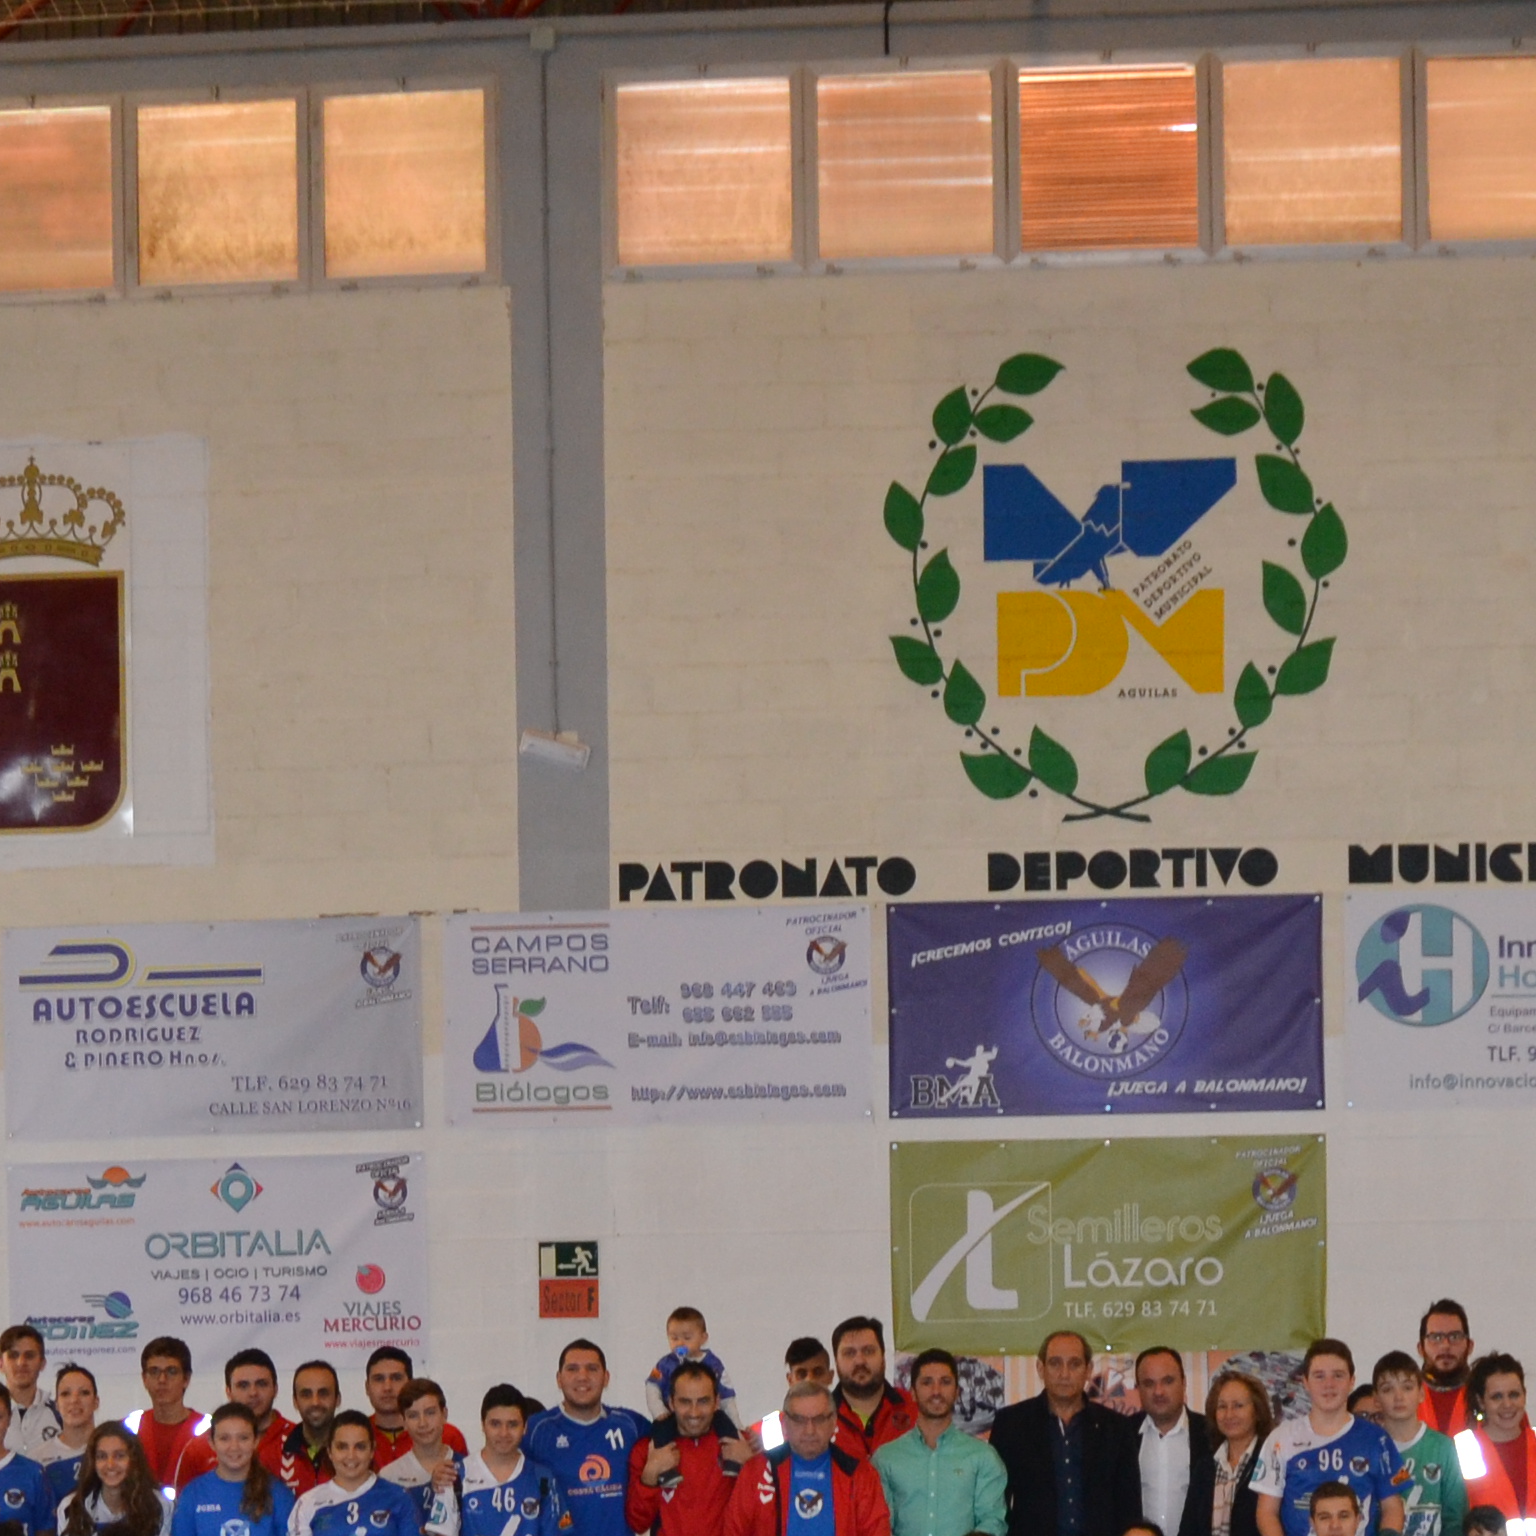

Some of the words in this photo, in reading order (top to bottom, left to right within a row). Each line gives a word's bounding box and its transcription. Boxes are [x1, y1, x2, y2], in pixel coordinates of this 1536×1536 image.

[1132, 539, 1192, 598] PATRONATO
[1144, 552, 1202, 609] DEPORTIVO
[1154, 564, 1212, 620] MUNICIPAL
[1118, 688, 1178, 699] AGUILAS
[618, 856, 916, 902] PATRONATO
[987, 847, 1279, 891] DEPORTIVO
[471, 933, 609, 954] CAMPOS
[998, 921, 1072, 947] CONTIGO!
[471, 955, 609, 975] SERRANO
[32, 992, 257, 1023] AUTOESCUELA
[75, 1026, 202, 1045] RODRIGUEZ
[1048, 1028, 1170, 1073] BALONMANO
[1488, 1045, 1521, 1063] TLF.
[231, 1075, 271, 1093] TLF.
[278, 1075, 310, 1094] 629
[316, 1075, 338, 1094] 83
[343, 1076, 364, 1094] 74
[369, 1076, 387, 1092] 71
[476, 1080, 609, 1104] Biólogos
[1176, 1081, 1187, 1093] A
[1194, 1078, 1307, 1095] BALONMANO!
[209, 1102, 258, 1117] CALLE
[262, 1101, 292, 1116] SAN
[298, 1100, 371, 1114] LORENZO
[1027, 1203, 1223, 1244] Semilleros
[145, 1228, 332, 1260] ORBITALIA
[151, 1268, 200, 1281] VIAJES
[213, 1267, 249, 1280] OCIO
[263, 1265, 328, 1279] TURISMO
[1064, 1244, 1223, 1289] Lázaro
[178, 1286, 212, 1304] 968
[220, 1286, 242, 1303] 46
[248, 1285, 270, 1302] 73
[278, 1284, 301, 1302] 74
[588, 1285, 595, 1312] F
[180, 1309, 301, 1326] www.orbitalia.es
[344, 1301, 402, 1317] VIAJES
[1064, 1302, 1096, 1318] TLF.
[1103, 1300, 1135, 1318] 629
[1141, 1300, 1162, 1317] 83
[1169, 1300, 1190, 1317] 74
[1197, 1299, 1217, 1316] 71
[323, 1315, 422, 1334] MERCURIO
[605, 1427, 626, 1452] 11
[1317, 1447, 1344, 1472] 96
[491, 1486, 517, 1513] 46
[345, 1500, 360, 1525] 3
